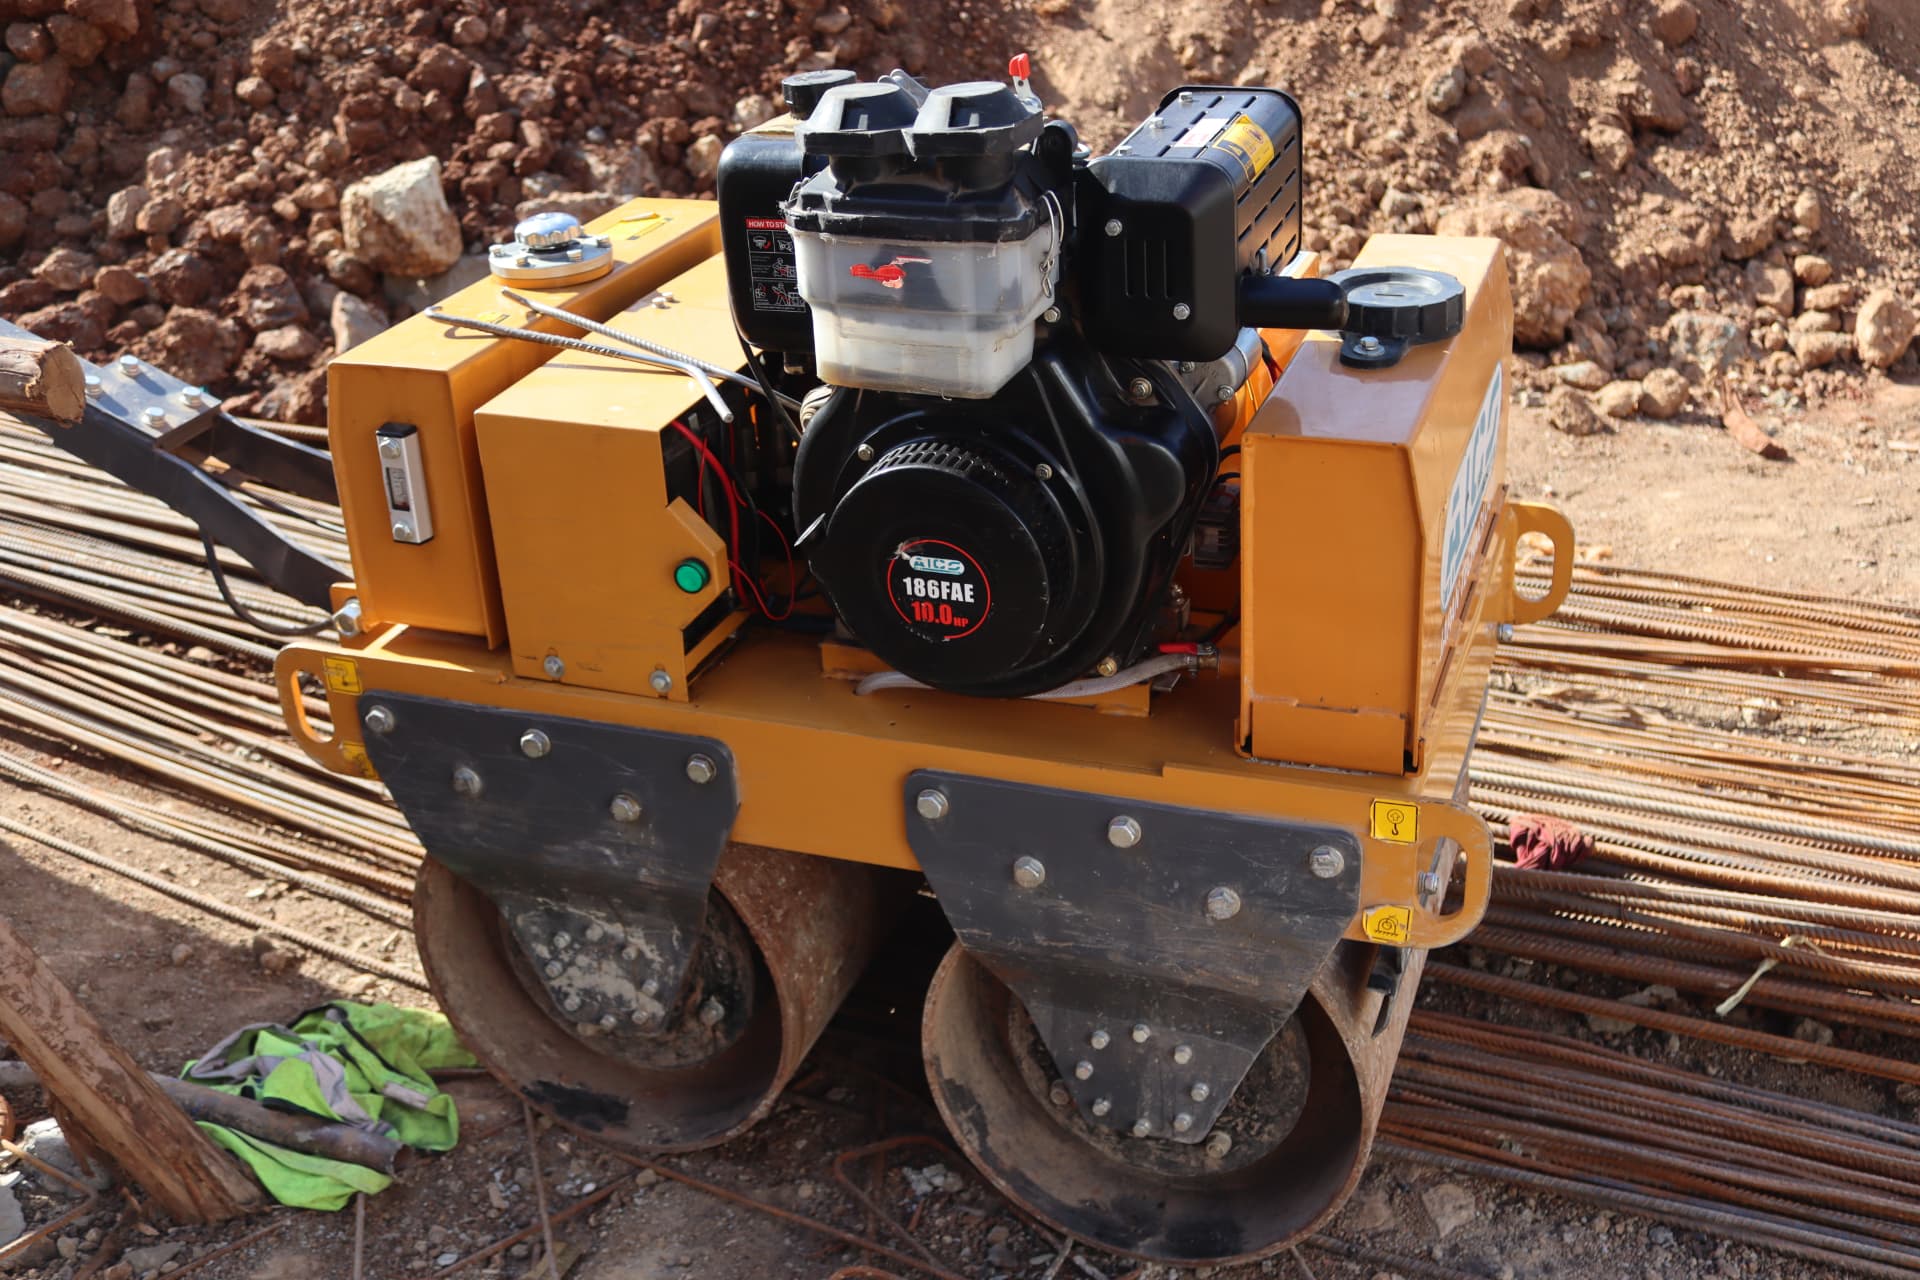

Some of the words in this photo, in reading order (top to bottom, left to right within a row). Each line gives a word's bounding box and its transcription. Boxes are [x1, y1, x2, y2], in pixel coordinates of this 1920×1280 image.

[748, 221, 764, 229] HOW
[766, 221, 775, 229] TO
[902, 576, 975, 603] 186FAE
[911, 601, 953, 625] 10.0
